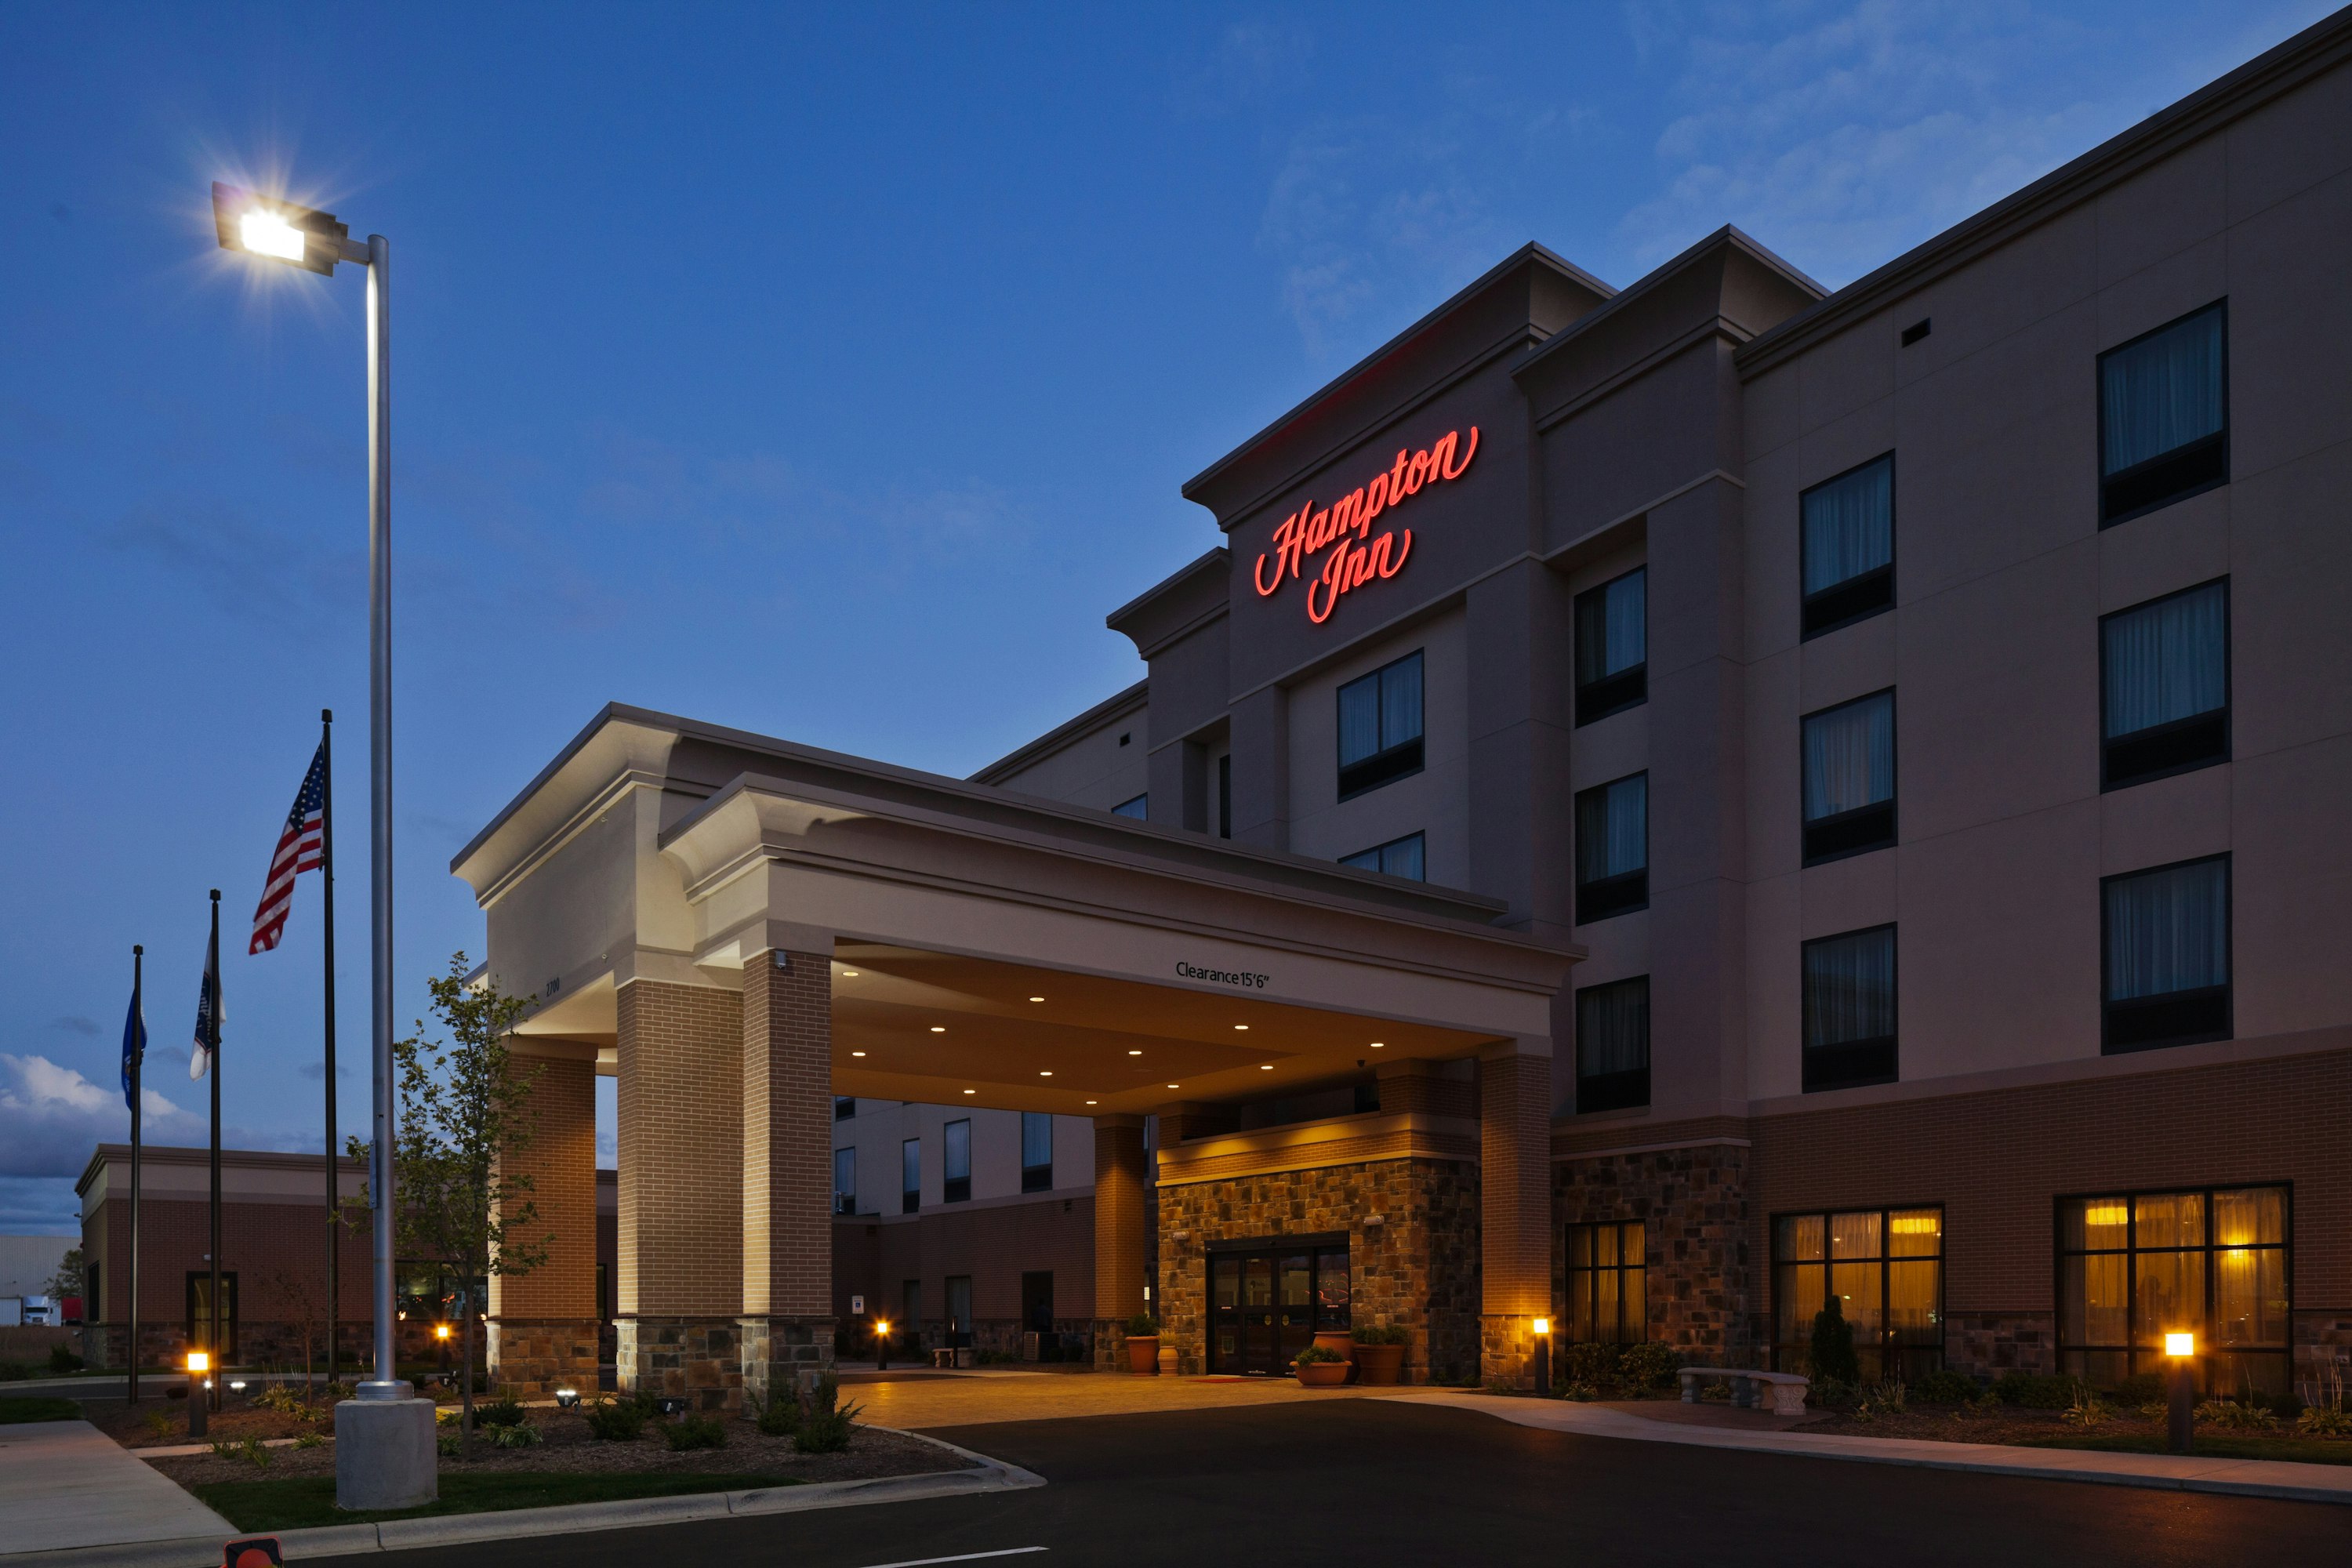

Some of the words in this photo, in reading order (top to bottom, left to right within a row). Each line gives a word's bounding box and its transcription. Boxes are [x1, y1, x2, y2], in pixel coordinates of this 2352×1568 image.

[1255, 426, 1479, 596] Hampton
[1307, 528, 1411, 623] Inn
[1176, 961, 1239, 985] Clearance
